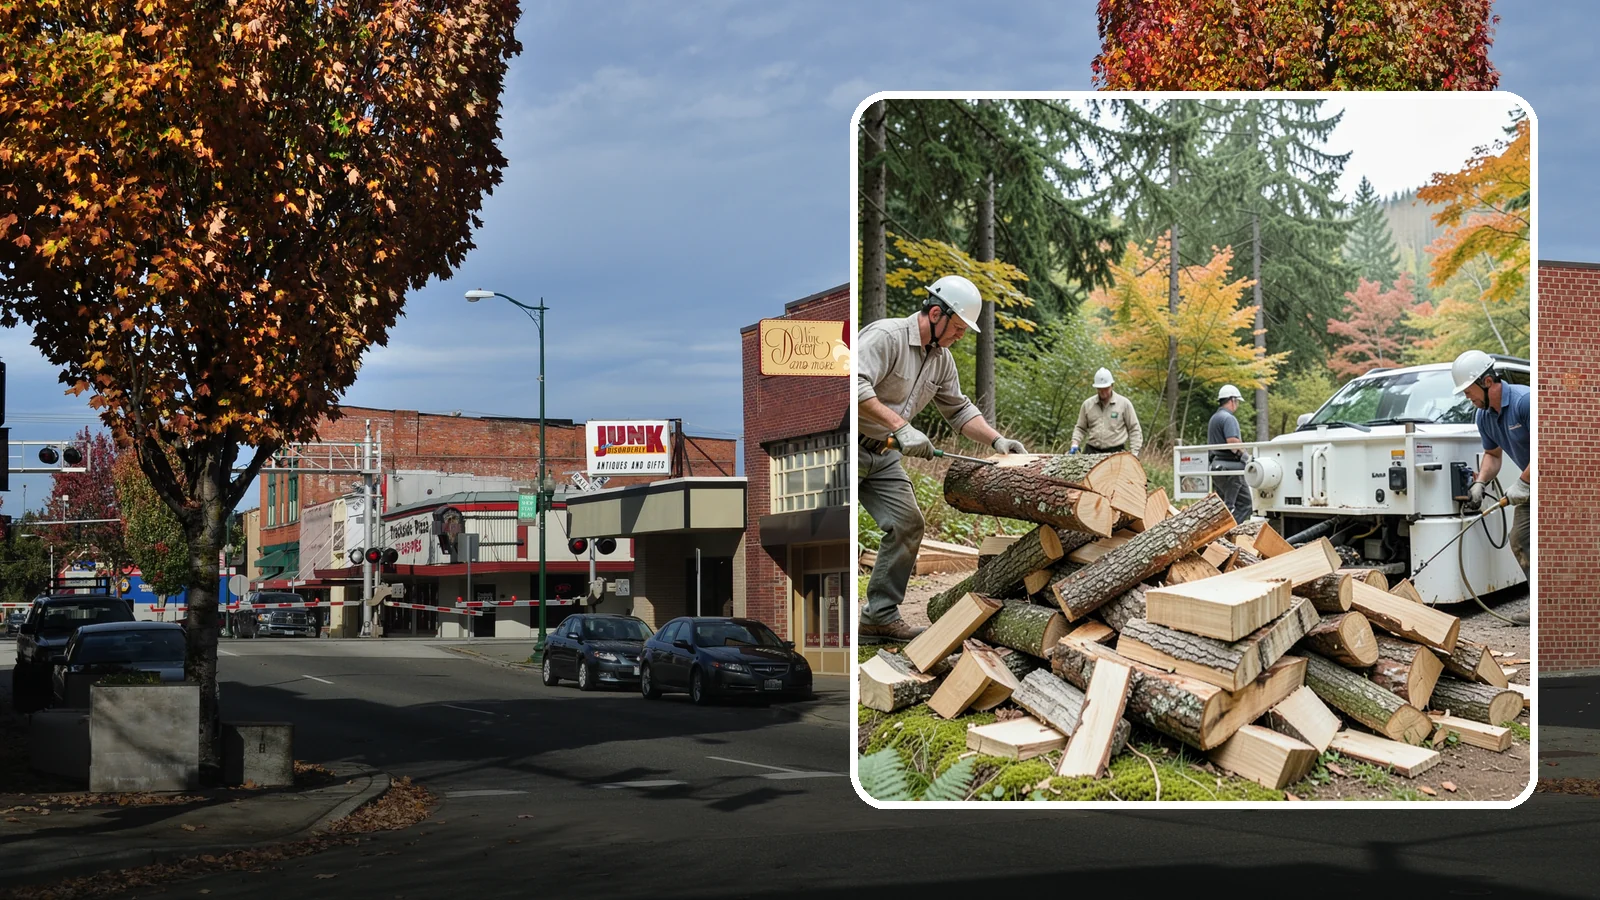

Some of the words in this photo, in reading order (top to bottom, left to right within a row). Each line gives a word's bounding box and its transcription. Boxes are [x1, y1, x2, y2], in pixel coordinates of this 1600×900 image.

[596, 425, 665, 457] JUNK
[607, 446, 646, 454] DISORDERLY
[596, 461, 628, 470] ANTIQUES
[631, 461, 644, 470] AND
[646, 460, 666, 470] GIFTS
[390, 521, 413, 540] Trackside
[414, 519, 429, 535] Pizza
